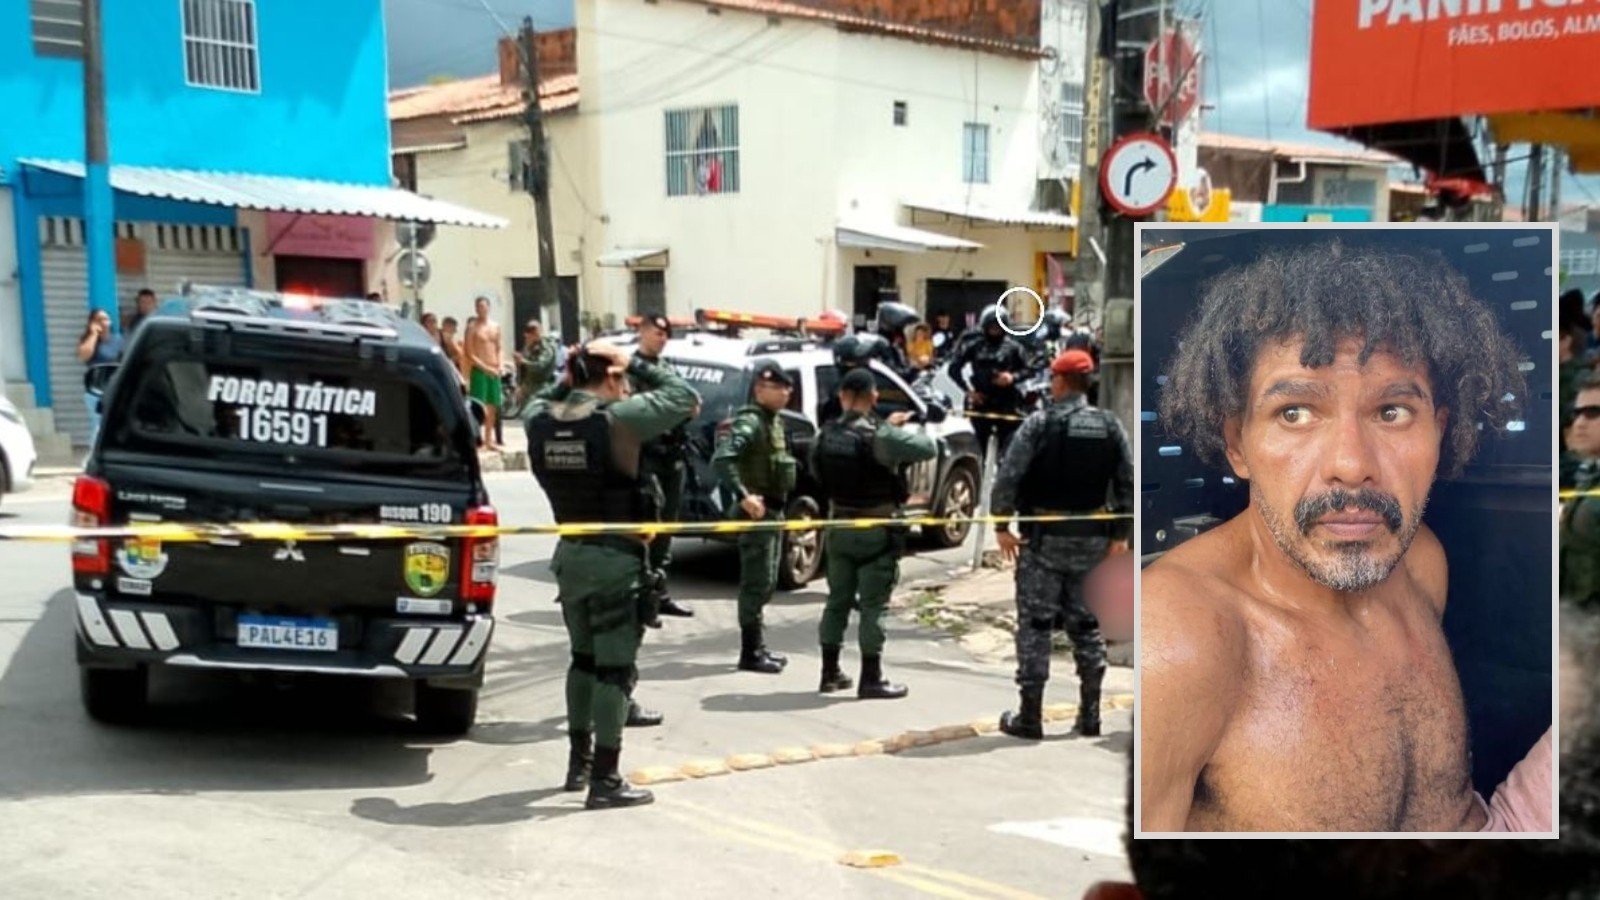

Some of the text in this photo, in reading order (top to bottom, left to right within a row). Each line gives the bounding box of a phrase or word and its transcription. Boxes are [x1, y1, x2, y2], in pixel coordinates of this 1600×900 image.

[1498, 17, 1560, 40] BOLOS,
[208, 376, 376, 416] FORÇA TÁTICA
[235, 406, 328, 447] 16591
[420, 503, 452, 523] 190
[249, 626, 328, 647] PAL4E16
